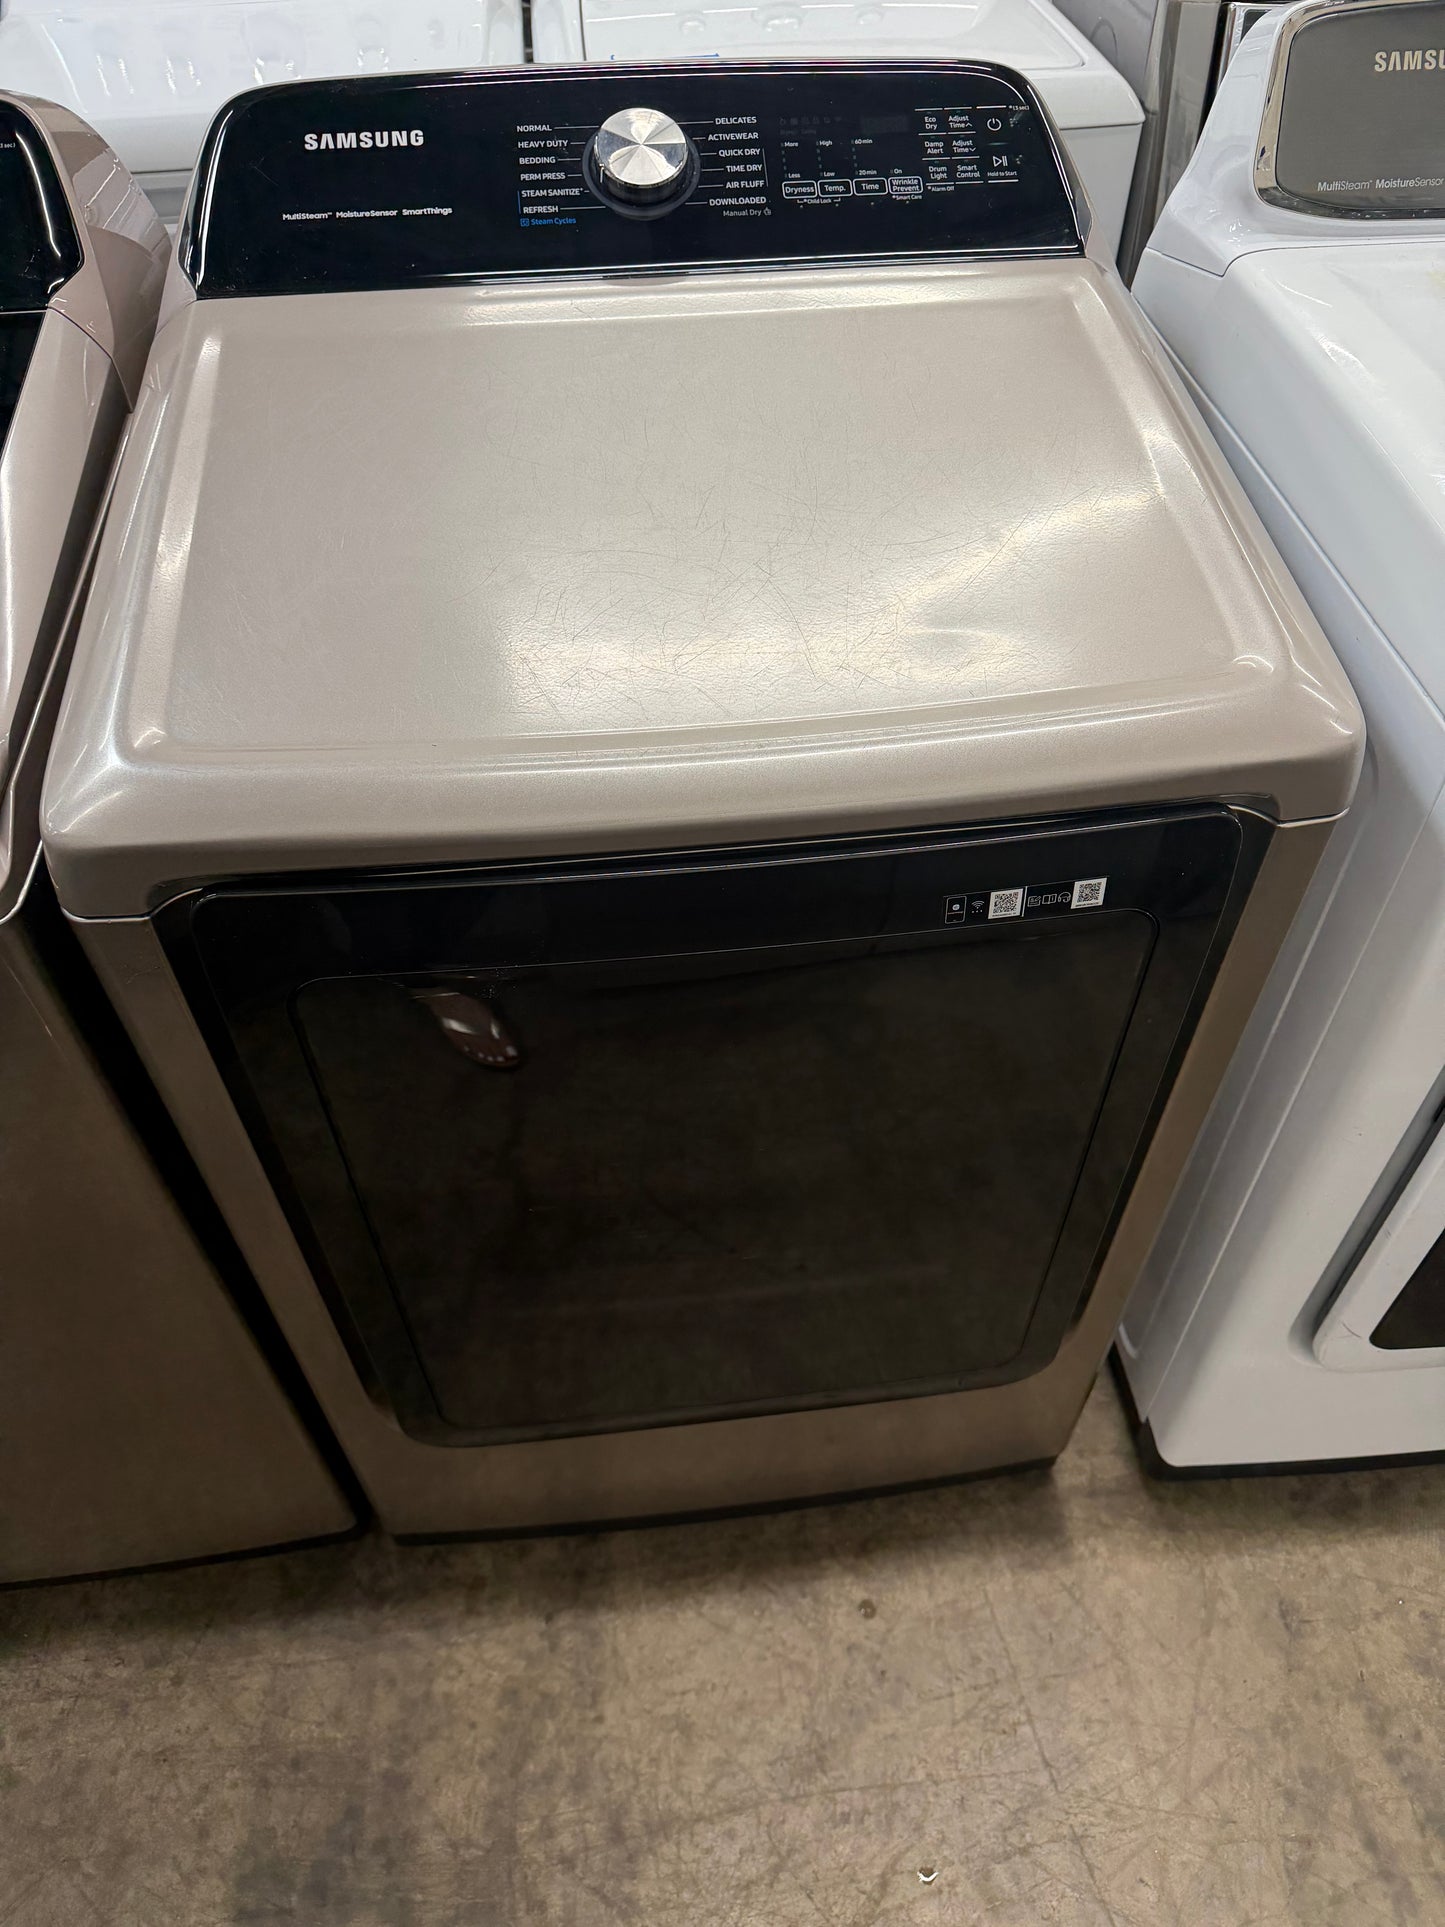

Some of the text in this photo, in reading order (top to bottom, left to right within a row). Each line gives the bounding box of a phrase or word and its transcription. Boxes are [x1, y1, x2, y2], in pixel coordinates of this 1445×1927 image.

[715, 116, 757, 125] DELICATES
[516, 124, 553, 133] NORMAL
[304, 129, 425, 151] SAMSUNG
[708, 132, 759, 141] ACTIVEWEAR
[518, 140, 568, 149] HEAVY DUTY
[924, 141, 944, 149] Damp
[718, 148, 761, 158] QUICK DRY
[953, 146, 969, 154] Time
[519, 156, 556, 165] BEDDING
[725, 164, 762, 173] TIME DRY
[957, 164, 978, 172] Smart
[520, 172, 566, 181] PERM PRESS
[930, 172, 948, 180] Light
[956, 170, 981, 178] Control
[725, 180, 765, 189] AIR FLUFF
[891, 178, 919, 186] Wrinkle
[1375, 176, 1445, 189] MoistureSensor
[785, 186, 815, 195] Dryness
[824, 184, 846, 192] Temp.
[861, 183, 880, 191] Time
[892, 185, 921, 193] Prevent
[521, 189, 547, 198] STEAM
[709, 197, 766, 206] DOWNLOADED
[335, 209, 398, 218] MoistureSensor
[402, 206, 453, 216] SmartThings
[523, 205, 559, 214] REFRESH
[723, 208, 762, 217] Manual Dry
[530, 216, 577, 226] Steam Cycles
